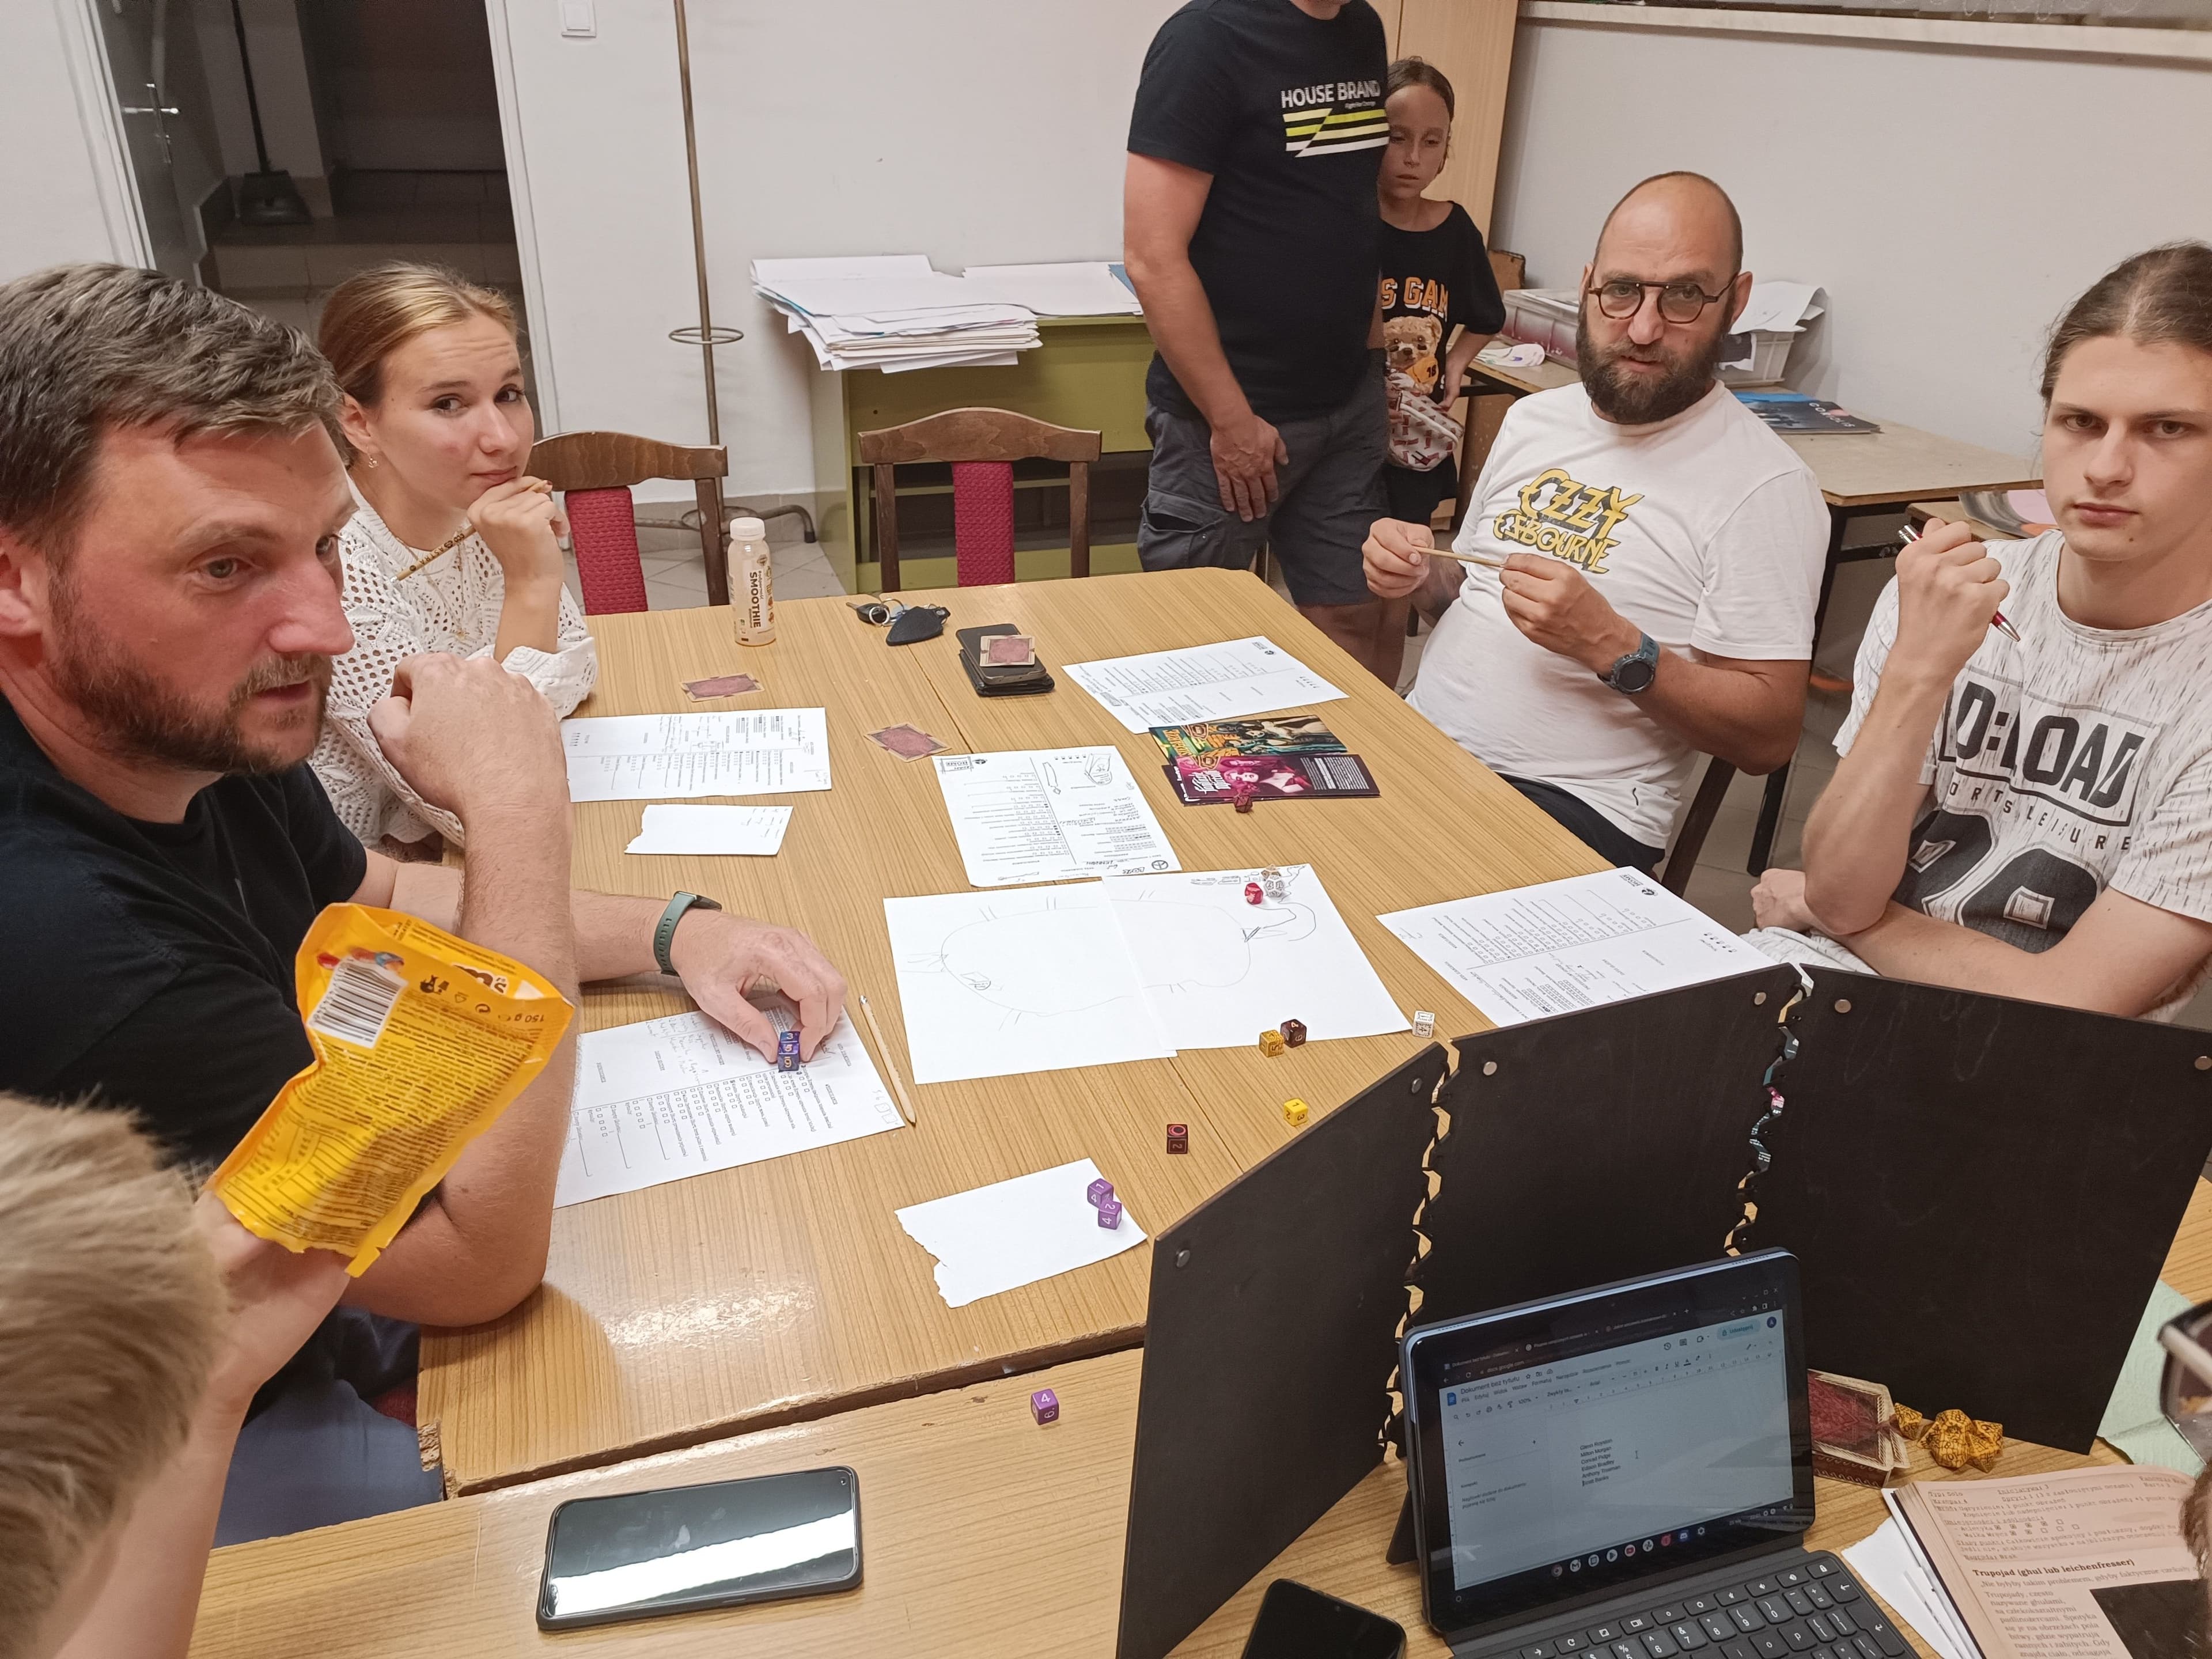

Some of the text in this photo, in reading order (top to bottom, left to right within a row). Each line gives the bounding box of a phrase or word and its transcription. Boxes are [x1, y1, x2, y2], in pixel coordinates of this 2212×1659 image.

[1281, 79, 1381, 108] HOUSE BRAND
[1518, 468, 1645, 540] OZZY
[1493, 509, 1621, 574] OSBOURNE
[749, 572, 761, 628] SMOOTHIE
[1620, 874, 1642, 886] HOME
[514, 1013, 544, 1022] 150 g
[1729, 1325, 1753, 1335] Udostępnij
[1487, 1361, 1524, 1373] docs.google.com
[1460, 1383, 1491, 1395] Dokument
[1502, 1376, 1520, 1387] tytułu
[1041, 1393, 1050, 1402] 4
[1594, 1446, 1612, 1455] Morgan
[1597, 1459, 1615, 1469] Bradley
[1582, 1471, 1600, 1479] Anthony
[2006, 1536, 2050, 1544] Całkowicie
[2052, 1532, 2085, 1541] spokojny
[1972, 1558, 2135, 1578] Trupojad (ghul lub leichenfresser)
[1997, 1580, 2021, 1589] byłyby
[2047, 1577, 2092, 1586] problemem,
[2094, 1573, 2118, 1583] gdyby
[2119, 1568, 2160, 1579] faktycznie
[1986, 1592, 2027, 1600] Trupojady,
[2031, 1599, 2066, 1607] ghulami,
[2005, 1606, 2077, 1615] człekokształtnymi
[2064, 1613, 2097, 1622] Spotyka
[2081, 1622, 2099, 1630] pola
[2058, 1631, 2100, 1641] wypatrują
[1654, 1645, 1662, 1653] 6
[2015, 1641, 2048, 1650] rannych
[2093, 1639, 2111, 1648] Gdy
[2072, 1649, 2111, 1658] odciągają
